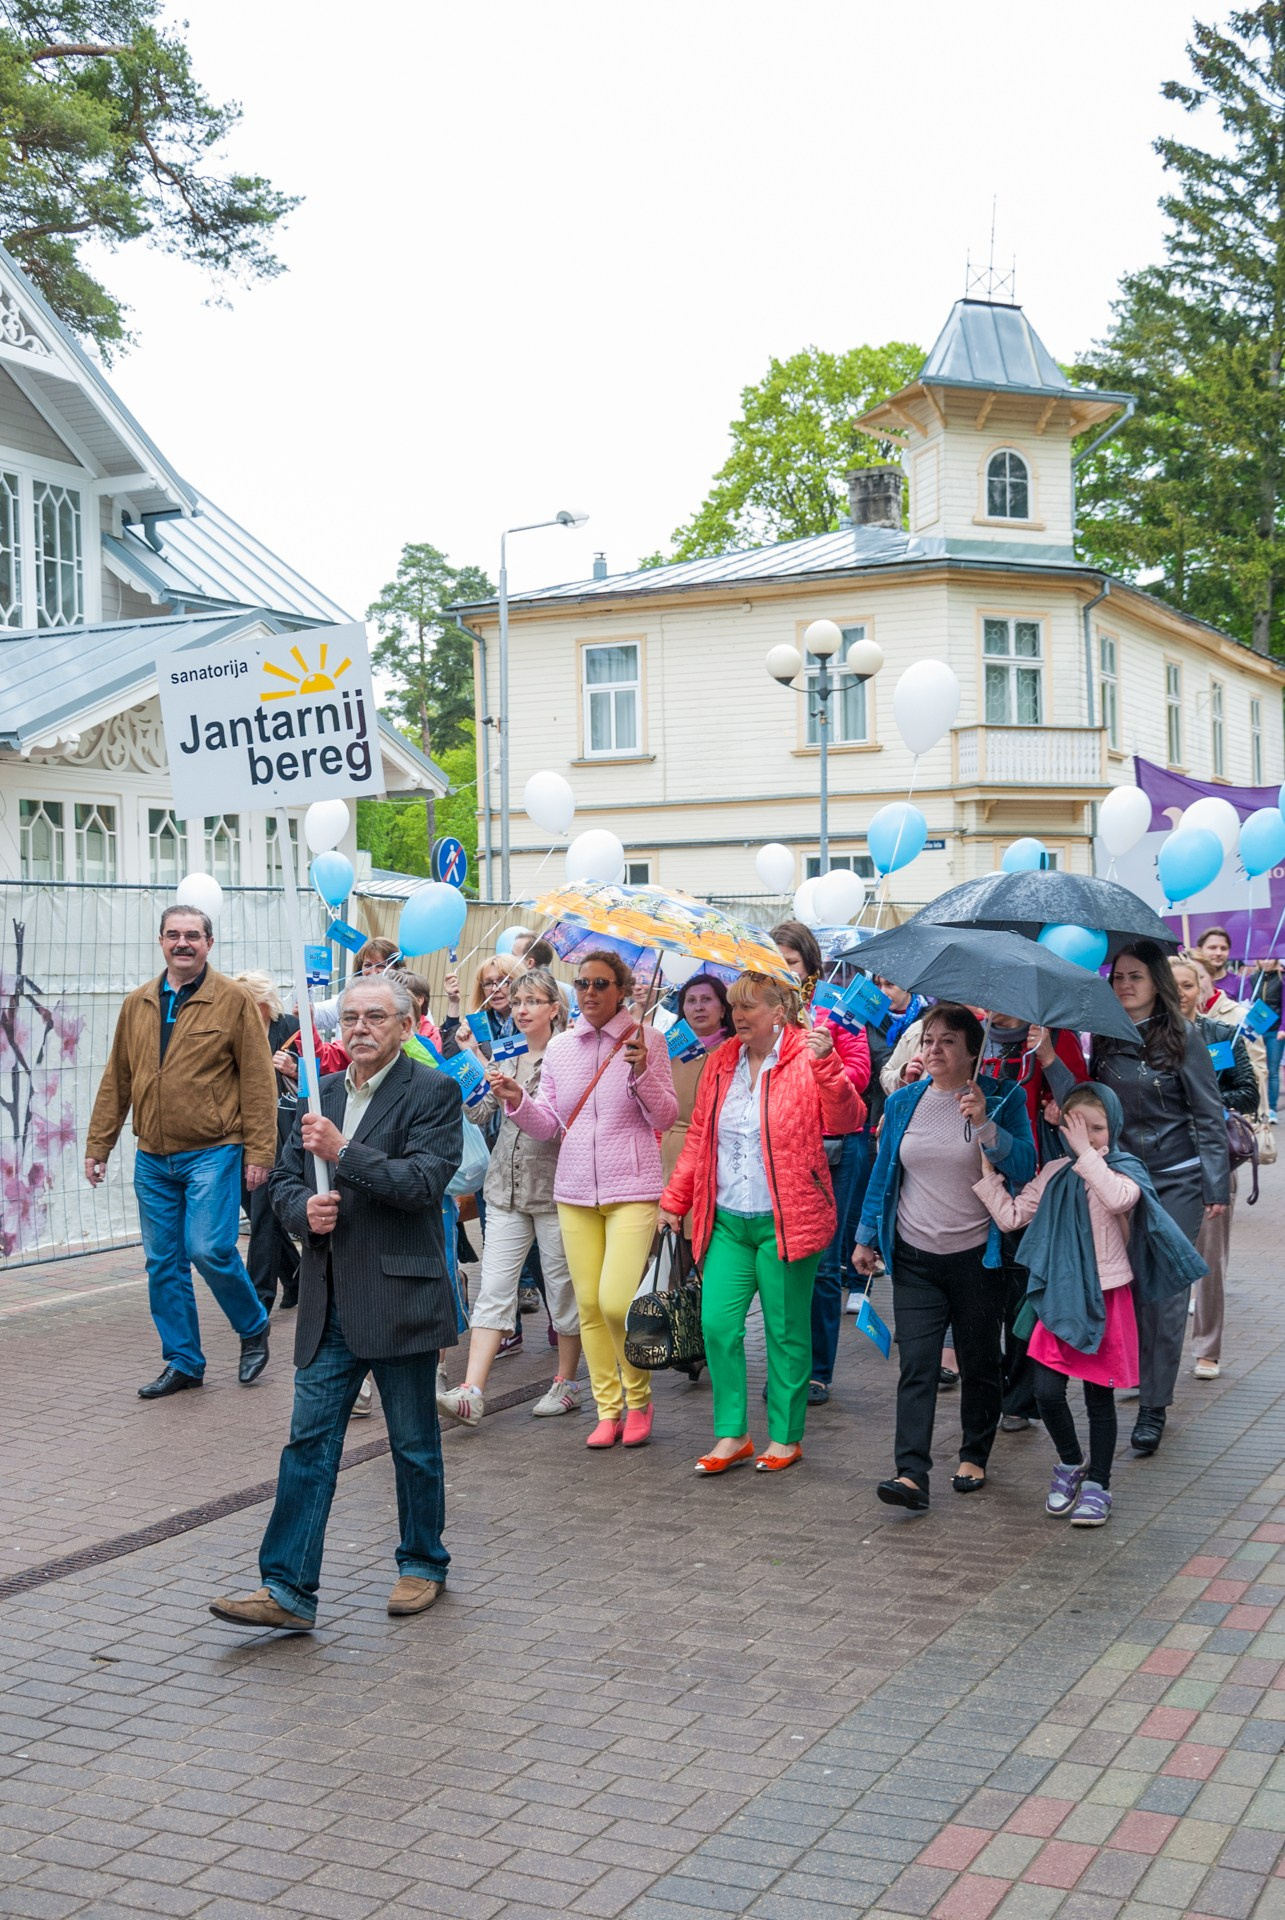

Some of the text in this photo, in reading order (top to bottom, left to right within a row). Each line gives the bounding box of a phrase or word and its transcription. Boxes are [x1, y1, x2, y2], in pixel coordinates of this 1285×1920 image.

[170, 659, 249, 685] sanatorija
[179, 688, 368, 755] Jantarnij
[247, 739, 372, 785] bereg
